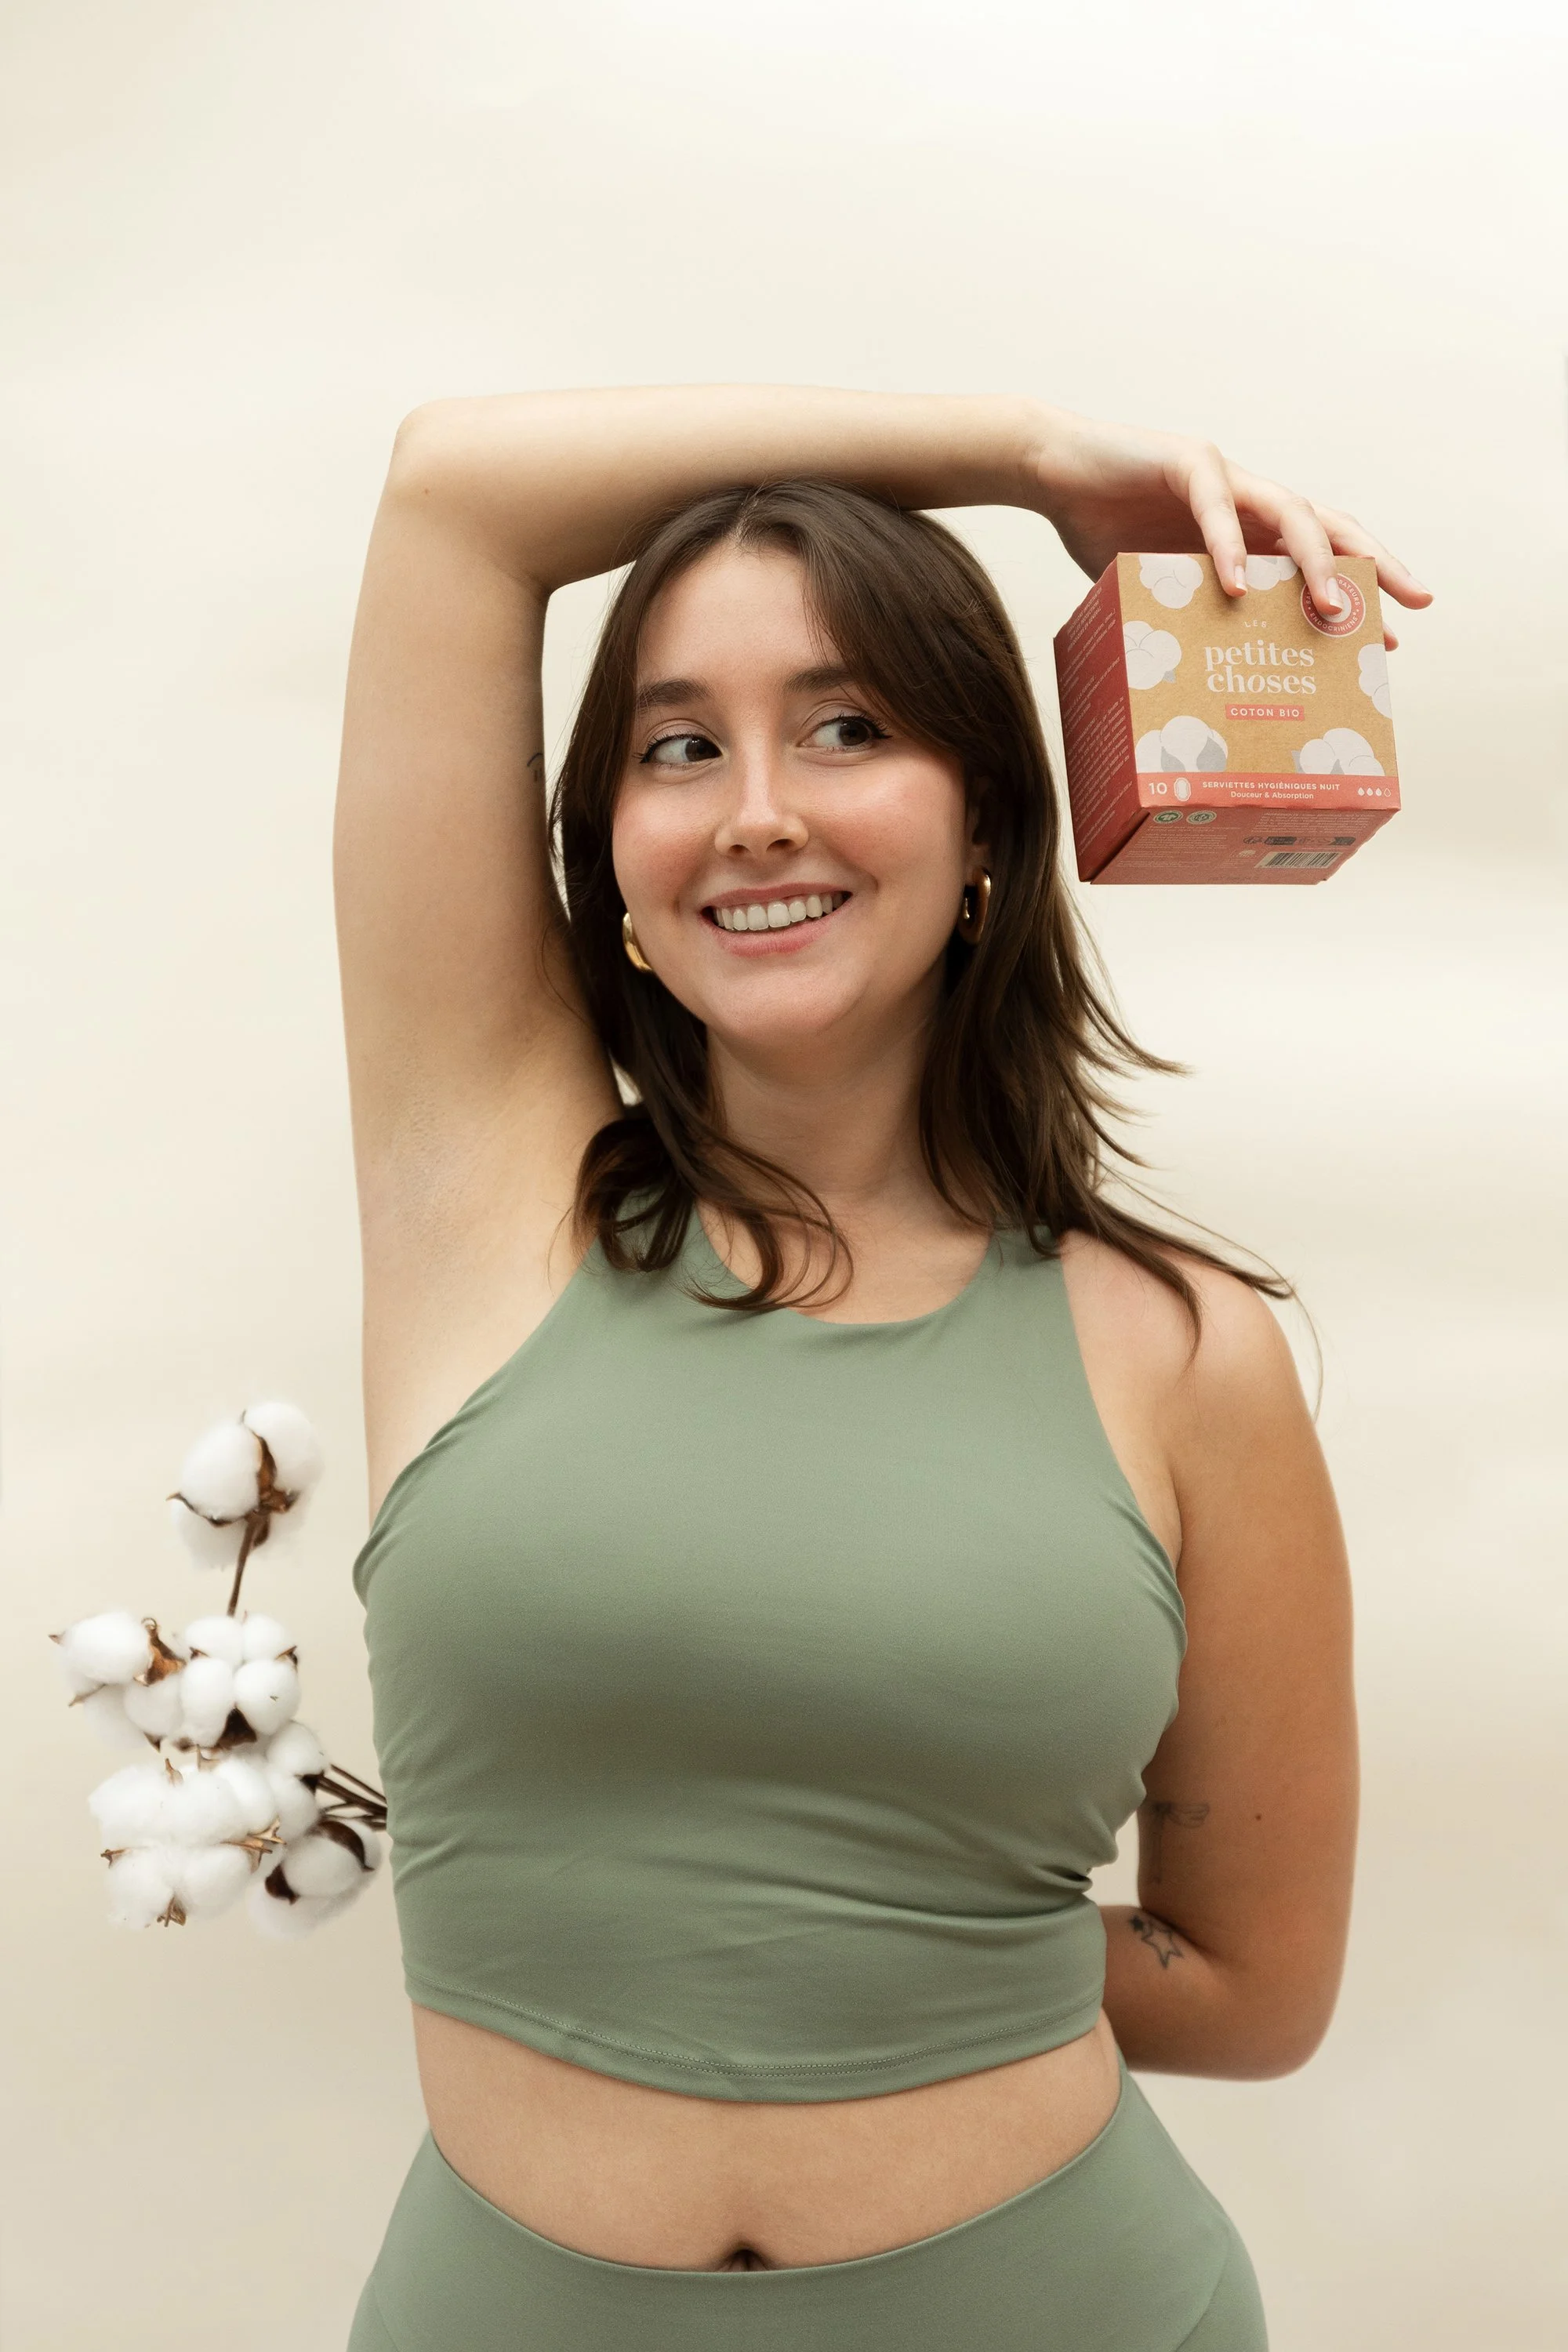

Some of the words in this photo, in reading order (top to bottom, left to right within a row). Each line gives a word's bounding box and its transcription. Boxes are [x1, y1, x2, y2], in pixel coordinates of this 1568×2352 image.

[1337, 579, 1360, 606] BATEURS
[1244, 619, 1267, 628] LES
[1310, 612, 1358, 632] ENDOCRINIENS
[1204, 640, 1315, 671] petites
[1207, 665, 1317, 695] choses
[1231, 708, 1274, 717] COTON
[1279, 709, 1300, 717] BIO
[1149, 782, 1167, 795] 10
[1258, 782, 1317, 790] HYGIÉNIQUES
